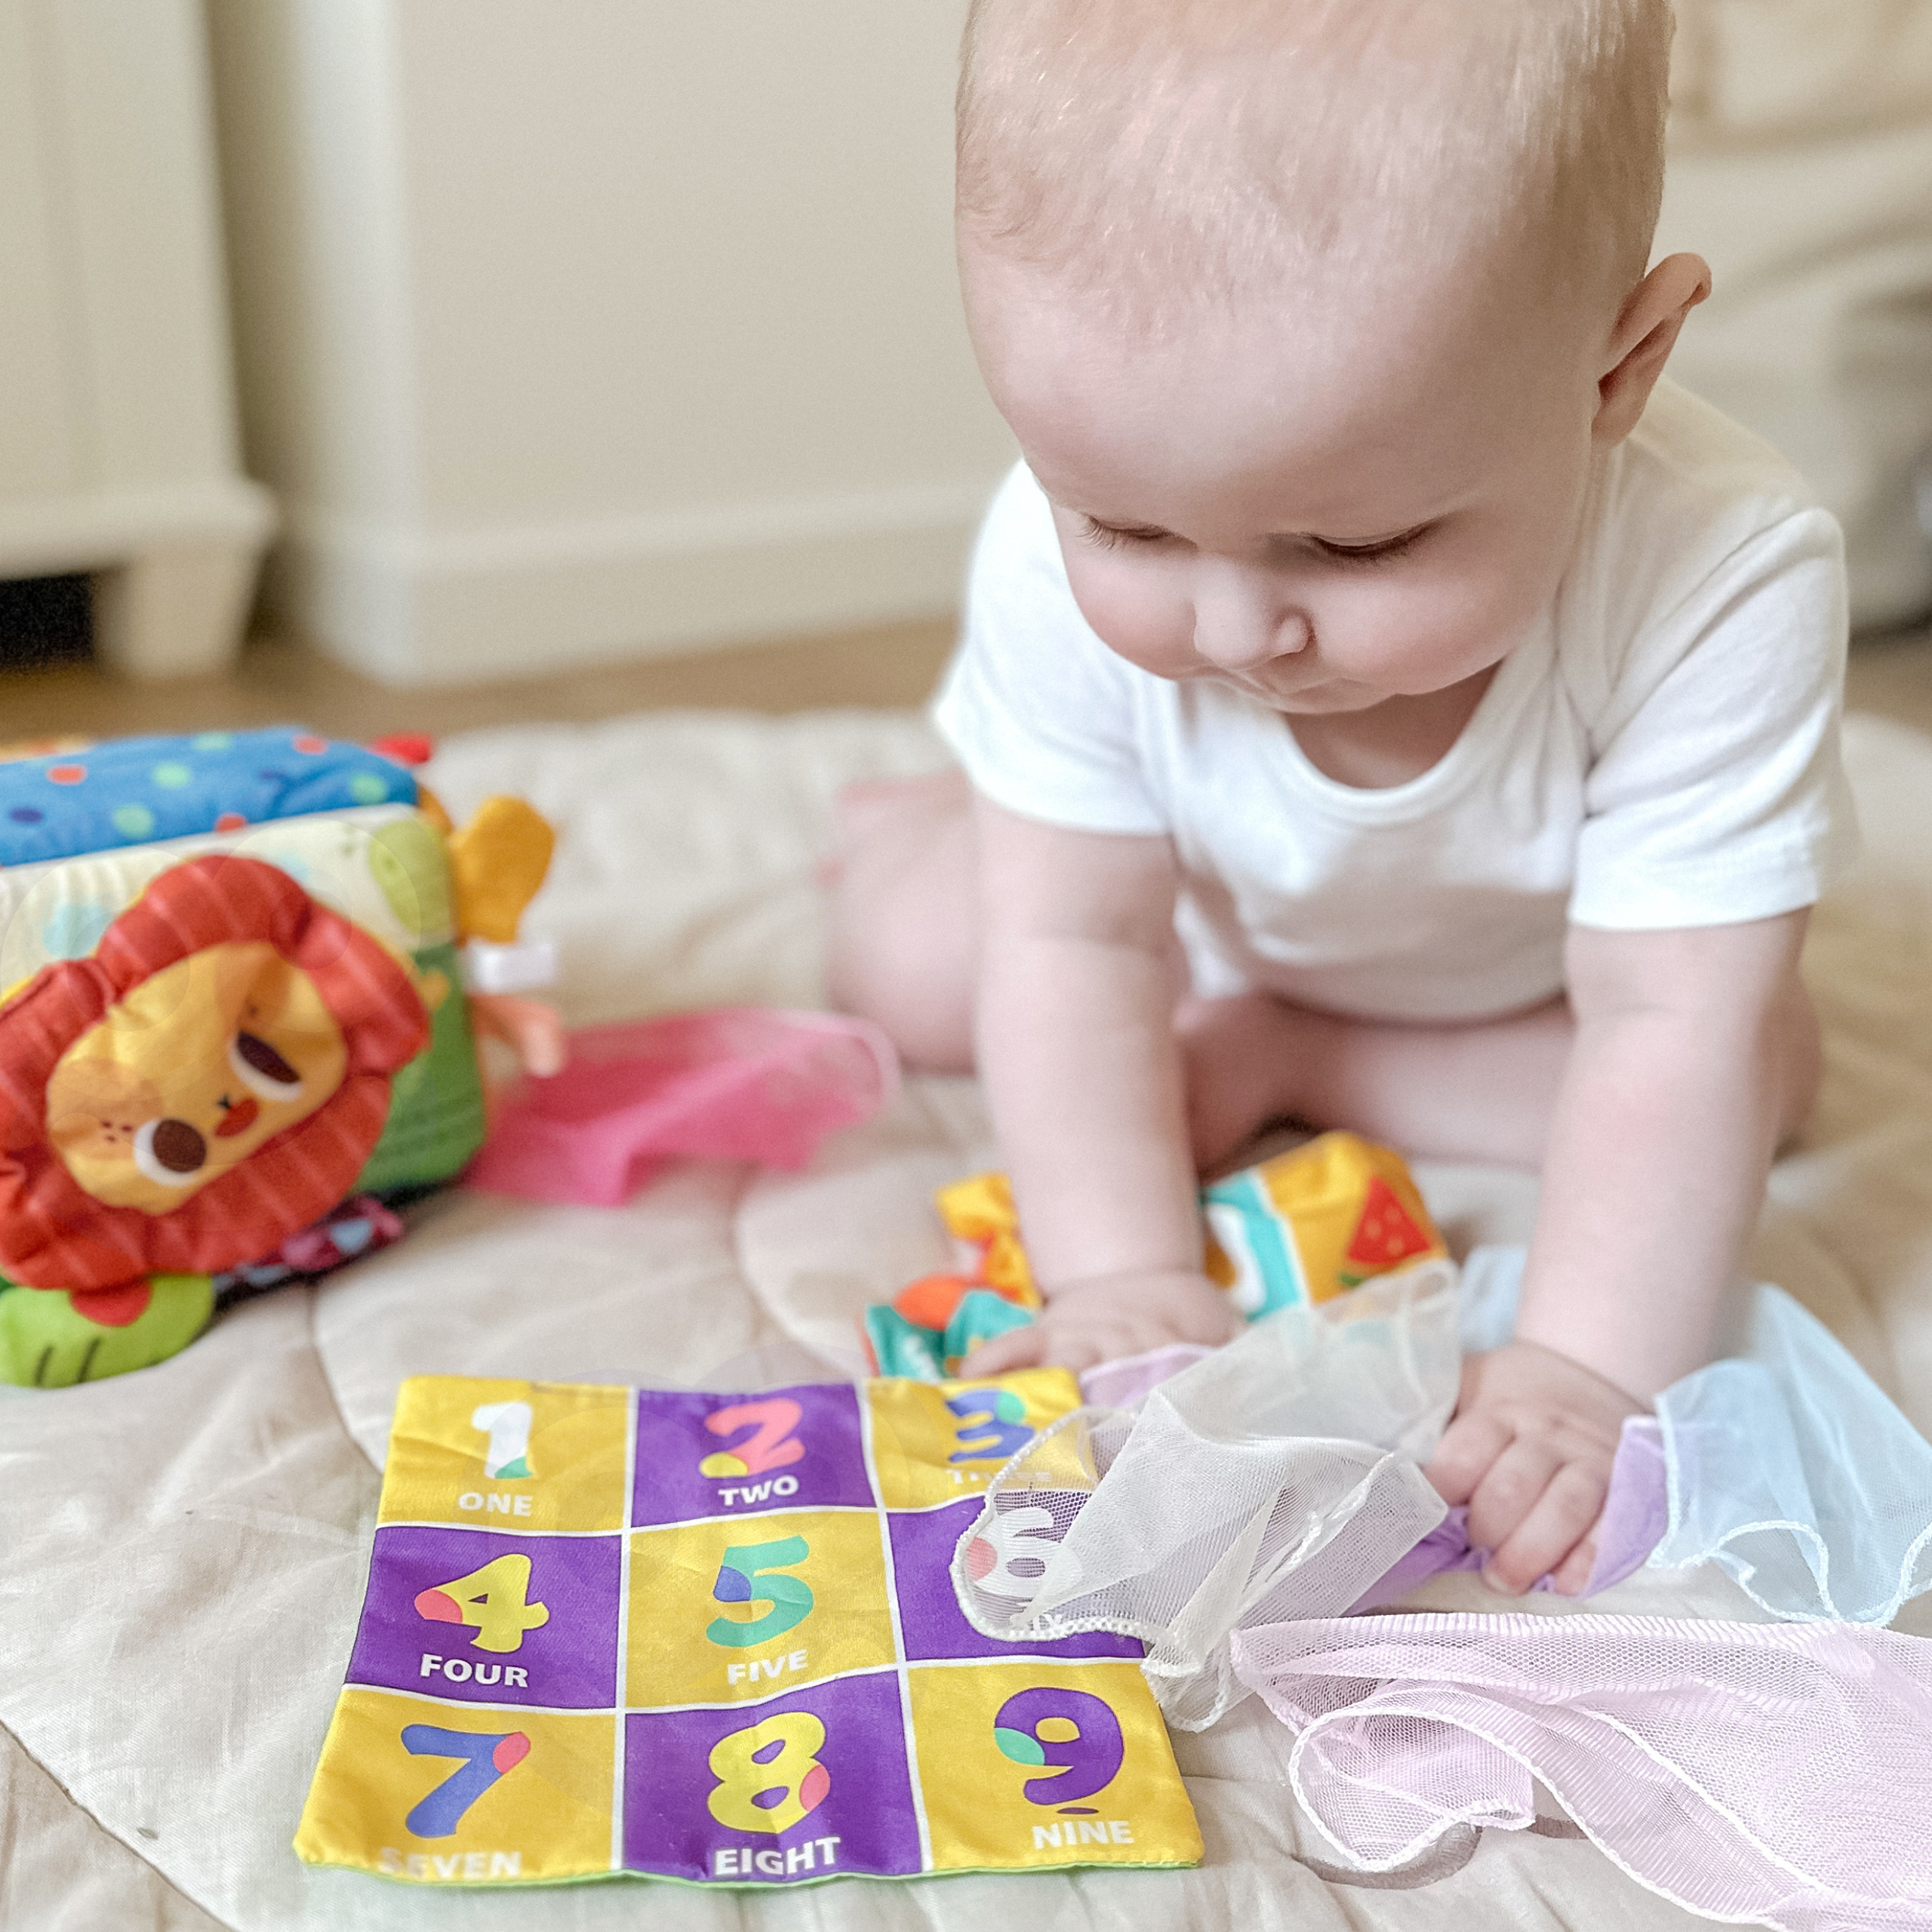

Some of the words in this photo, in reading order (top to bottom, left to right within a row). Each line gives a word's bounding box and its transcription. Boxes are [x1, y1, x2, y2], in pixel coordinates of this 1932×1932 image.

[471, 1400, 533, 1479] 1
[700, 1398, 805, 1478] 2
[946, 1389, 1035, 1463] 3
[458, 1491, 533, 1517] ONE
[718, 1475, 799, 1506] TWO
[414, 1552, 549, 1653] 4
[706, 1535, 814, 1647] 5
[420, 1654, 529, 1687] FOUR
[728, 1650, 808, 1685] FIVE
[401, 1724, 531, 1838] 7
[707, 1711, 830, 1834] 8
[994, 1687, 1124, 1805] 9
[379, 1846, 521, 1878] SEVEN
[714, 1837, 840, 1875] EIGHT
[1033, 1820, 1134, 1849] NINE
